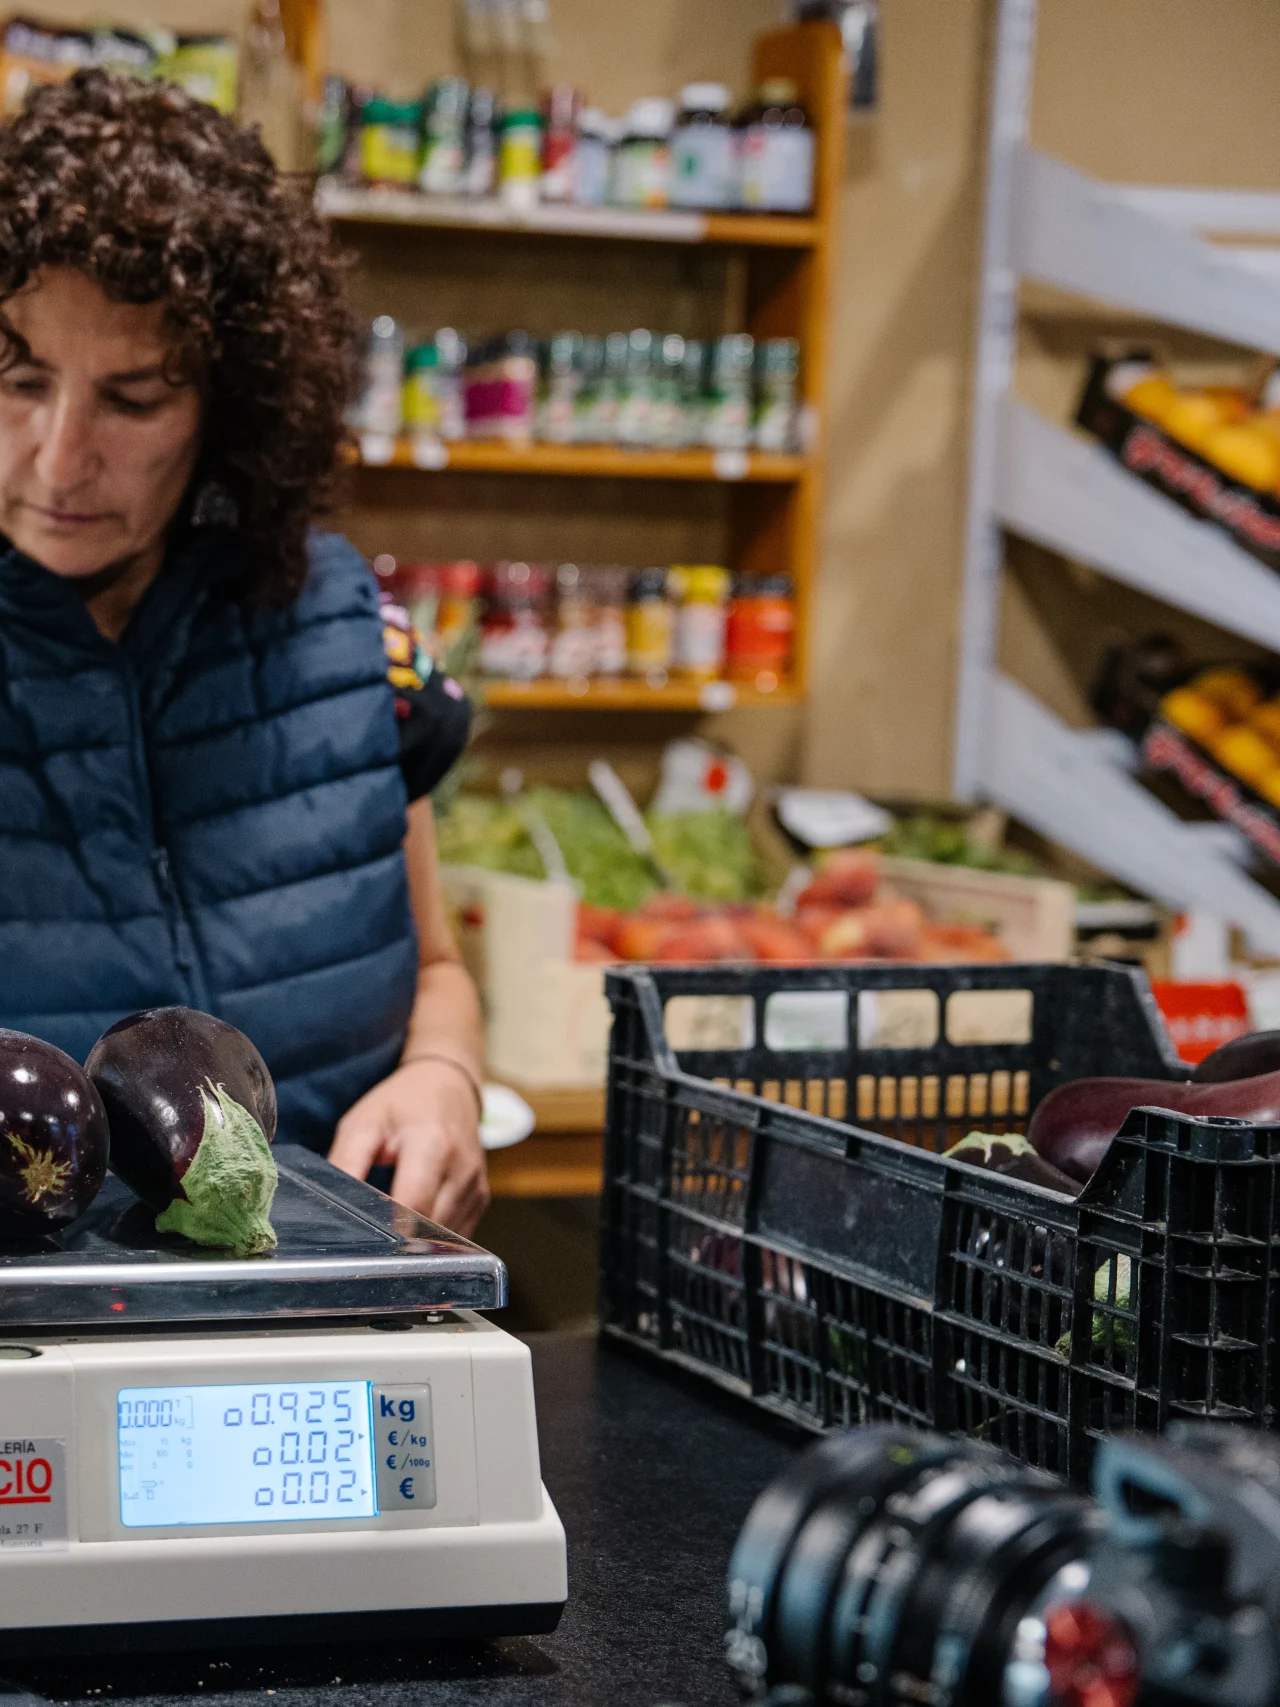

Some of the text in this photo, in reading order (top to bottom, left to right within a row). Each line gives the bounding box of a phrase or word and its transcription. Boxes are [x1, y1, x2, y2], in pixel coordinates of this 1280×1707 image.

[380, 1394, 416, 1422] kg
[398, 1477, 415, 1500] €
[16, 1524, 29, 1534] 27
[34, 1523, 43, 1534] F
